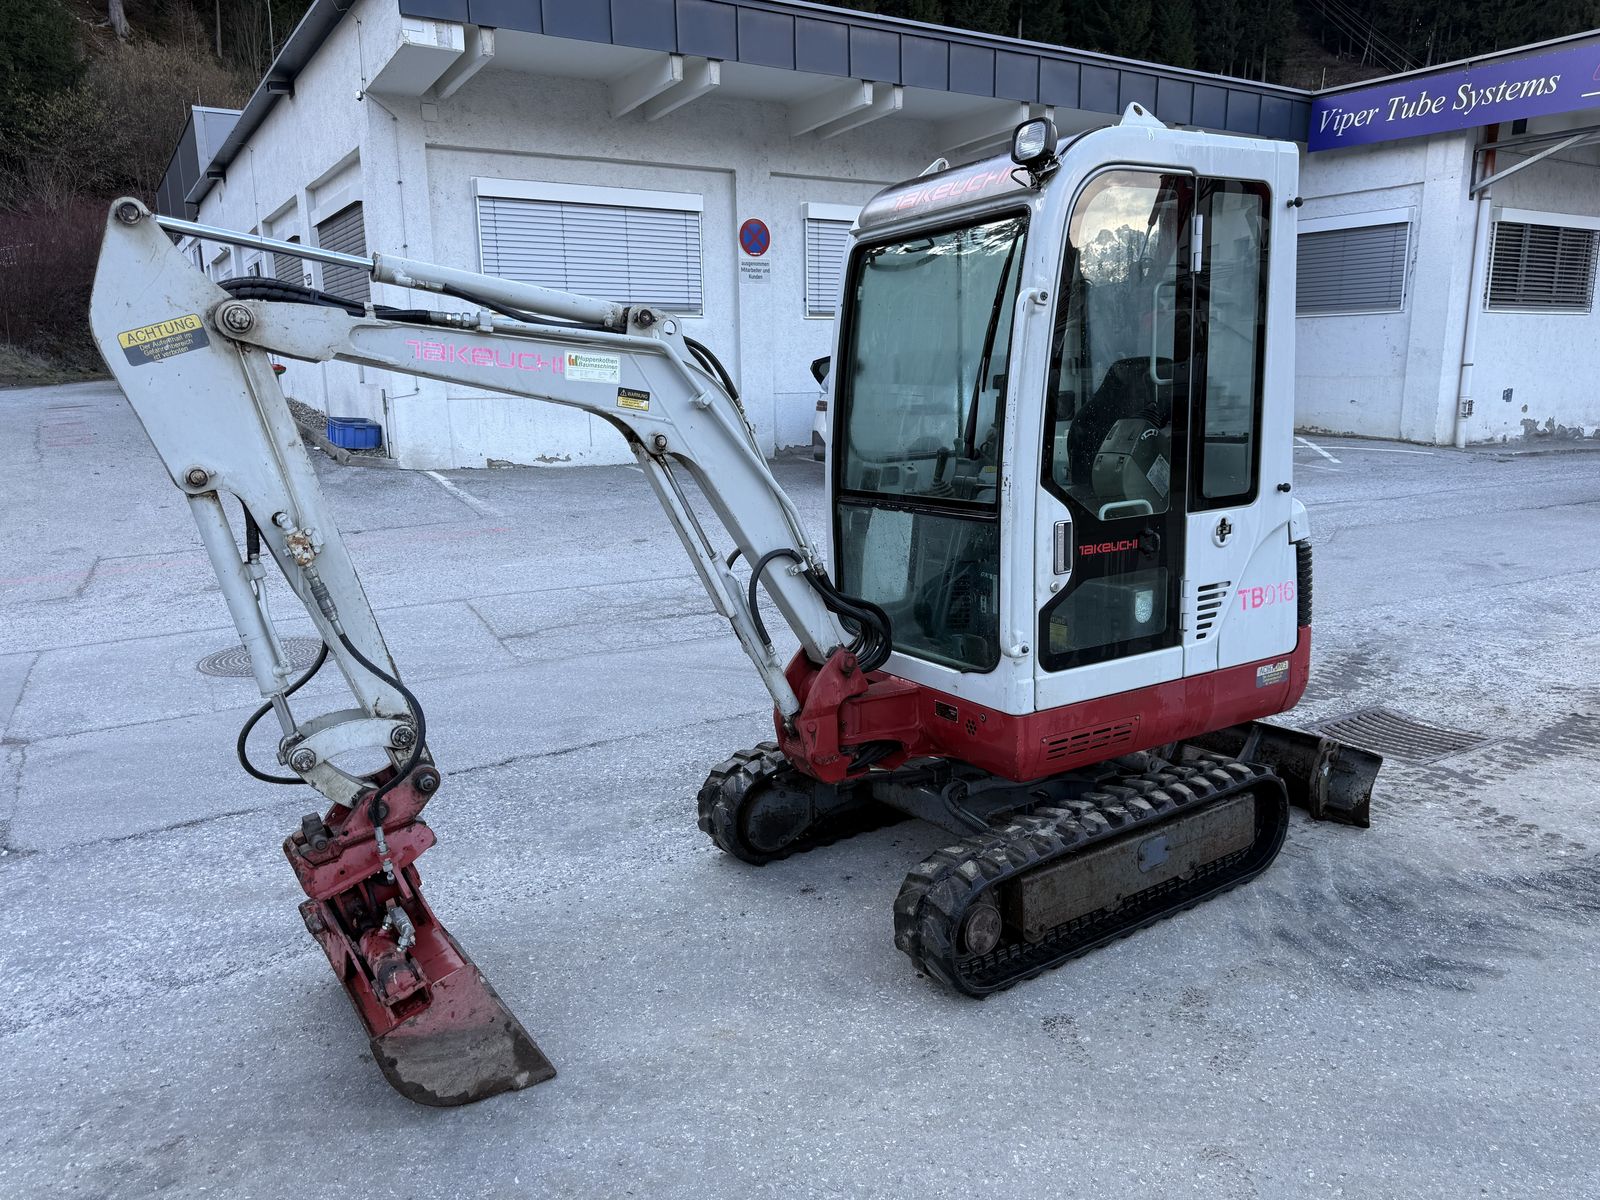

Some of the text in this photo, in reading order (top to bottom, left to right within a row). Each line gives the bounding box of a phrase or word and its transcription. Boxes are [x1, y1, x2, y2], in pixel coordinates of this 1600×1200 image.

[1319, 74, 1561, 136] Viper Tube Systems
[895, 166, 1015, 210] TAKEUCHI
[127, 317, 196, 345] ACHTUNG
[139, 343, 151, 352] Der
[153, 346, 189, 361] ist verboten
[405, 339, 564, 375] TAKEUCHI
[577, 355, 618, 365] Huppenkothen
[577, 361, 618, 370] Baumaschinen
[1079, 539, 1138, 555] TAKEUCHI
[1237, 580, 1295, 610] TB016
